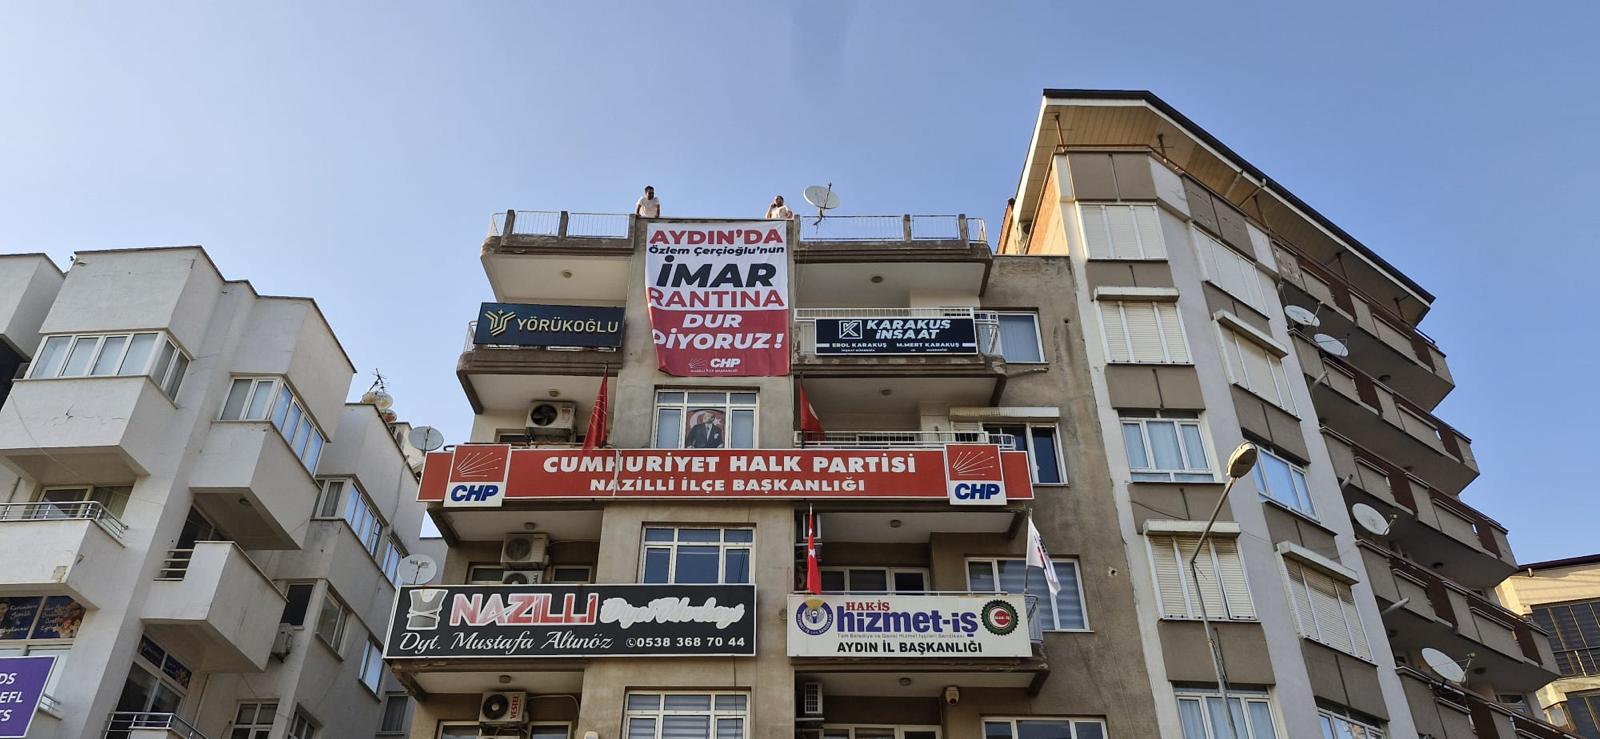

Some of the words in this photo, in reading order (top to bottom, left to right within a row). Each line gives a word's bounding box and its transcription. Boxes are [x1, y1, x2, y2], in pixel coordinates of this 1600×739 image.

[649, 229, 783, 245] AYDIN'DA
[649, 245, 690, 255] Özlem
[693, 246, 785, 257] Çerçioğlu'nun
[656, 255, 777, 288] İMAR
[647, 287, 785, 308] RANTINA
[517, 315, 619, 333] YÖRÜKOĞLU
[682, 314, 743, 328] DUR
[710, 358, 741, 368] CHP
[543, 452, 720, 473] CUMHURİYET
[729, 455, 803, 472] HALK
[812, 452, 916, 473] PARTİSİ
[450, 484, 499, 502] CHP
[590, 476, 675, 491] NAZİLLİ
[680, 476, 725, 493] İLÇE
[732, 476, 865, 493] BAŞKANLIĞI
[955, 482, 1000, 500] CHP
[836, 605, 979, 638] hizmet-iş
[399, 632, 441, 654] Dyt.
[450, 630, 535, 655] Mustafa
[540, 630, 614, 650] Altınöz
[636, 637, 671, 648] 0538
[676, 637, 701, 648] 368
[706, 637, 723, 648] 70
[727, 636, 745, 648] 44
[837, 641, 879, 653] AYDIN
[882, 640, 895, 653] İL
[899, 640, 983, 656] BAŞKANLIĞI
